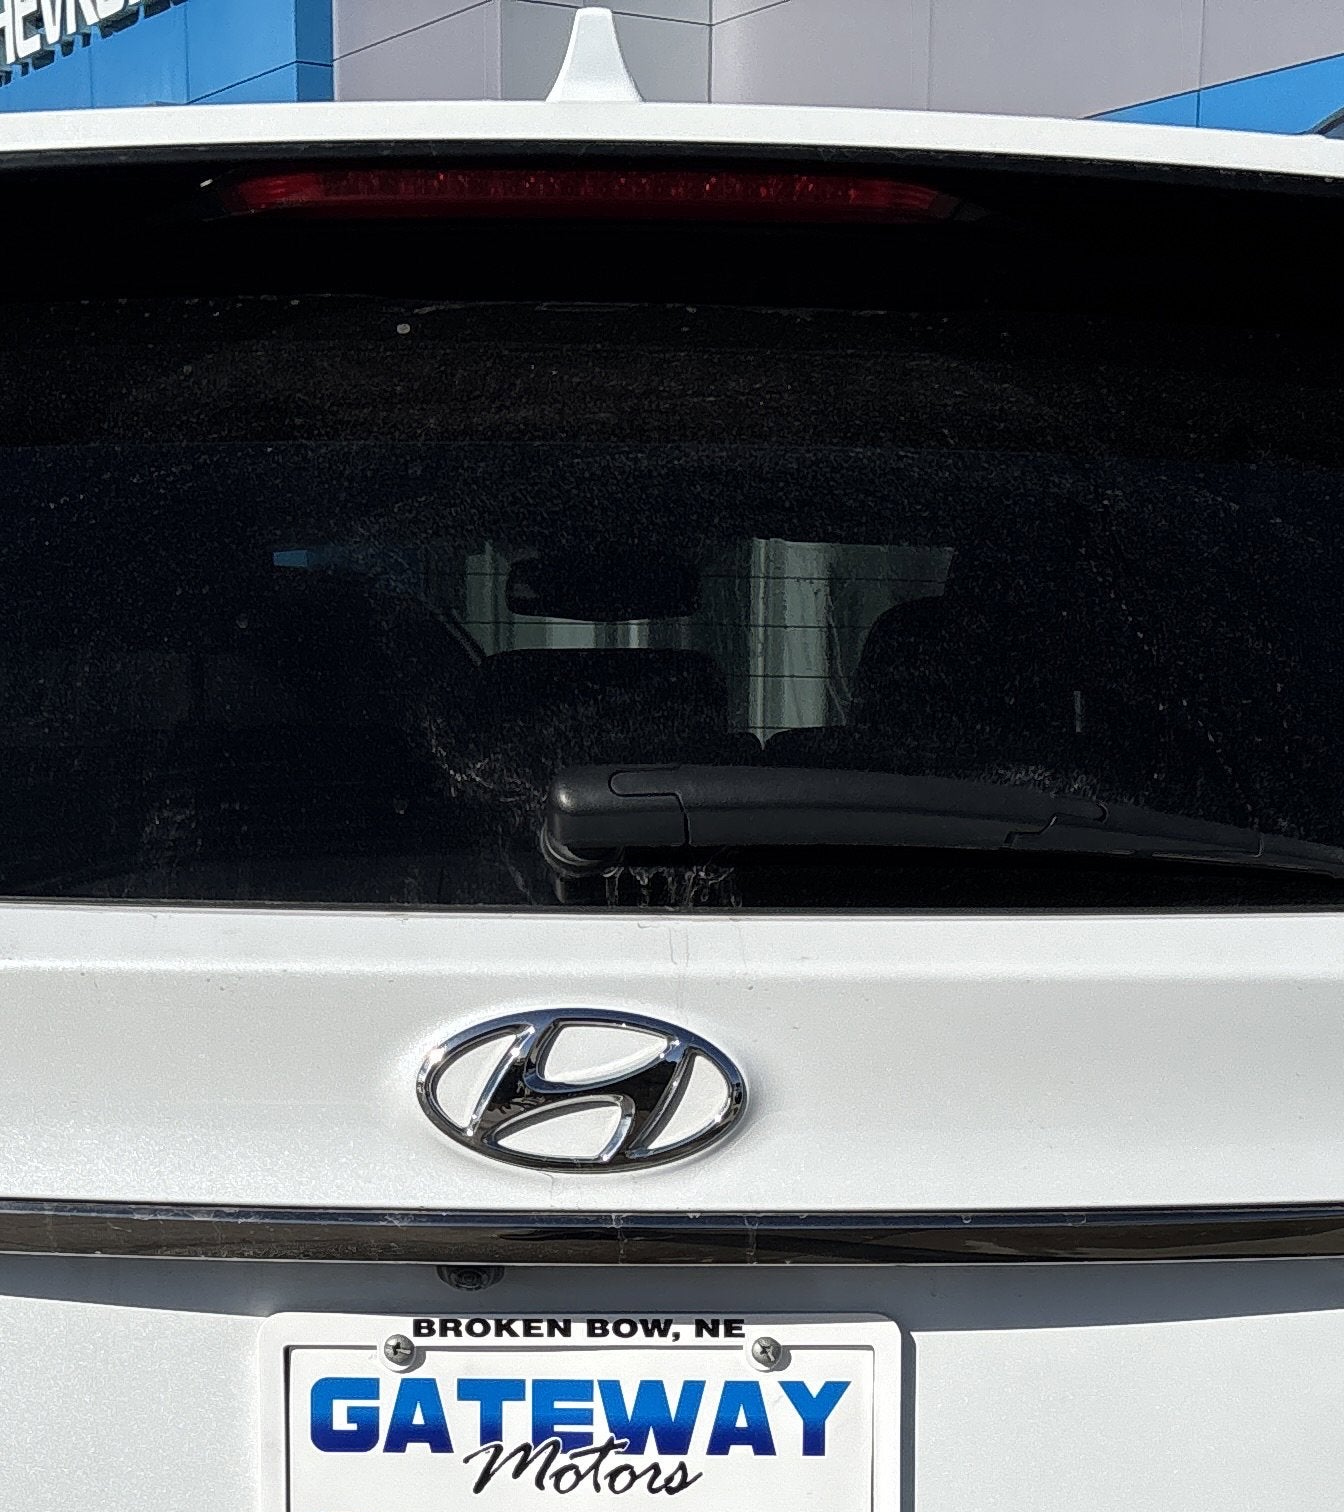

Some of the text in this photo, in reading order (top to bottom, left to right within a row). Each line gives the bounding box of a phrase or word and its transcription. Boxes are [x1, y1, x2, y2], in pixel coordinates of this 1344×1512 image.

[412, 1318, 746, 1342] BROKEN BOW, NE
[309, 1376, 852, 1457] GATEWAY
[462, 1435, 703, 1496] Motors
